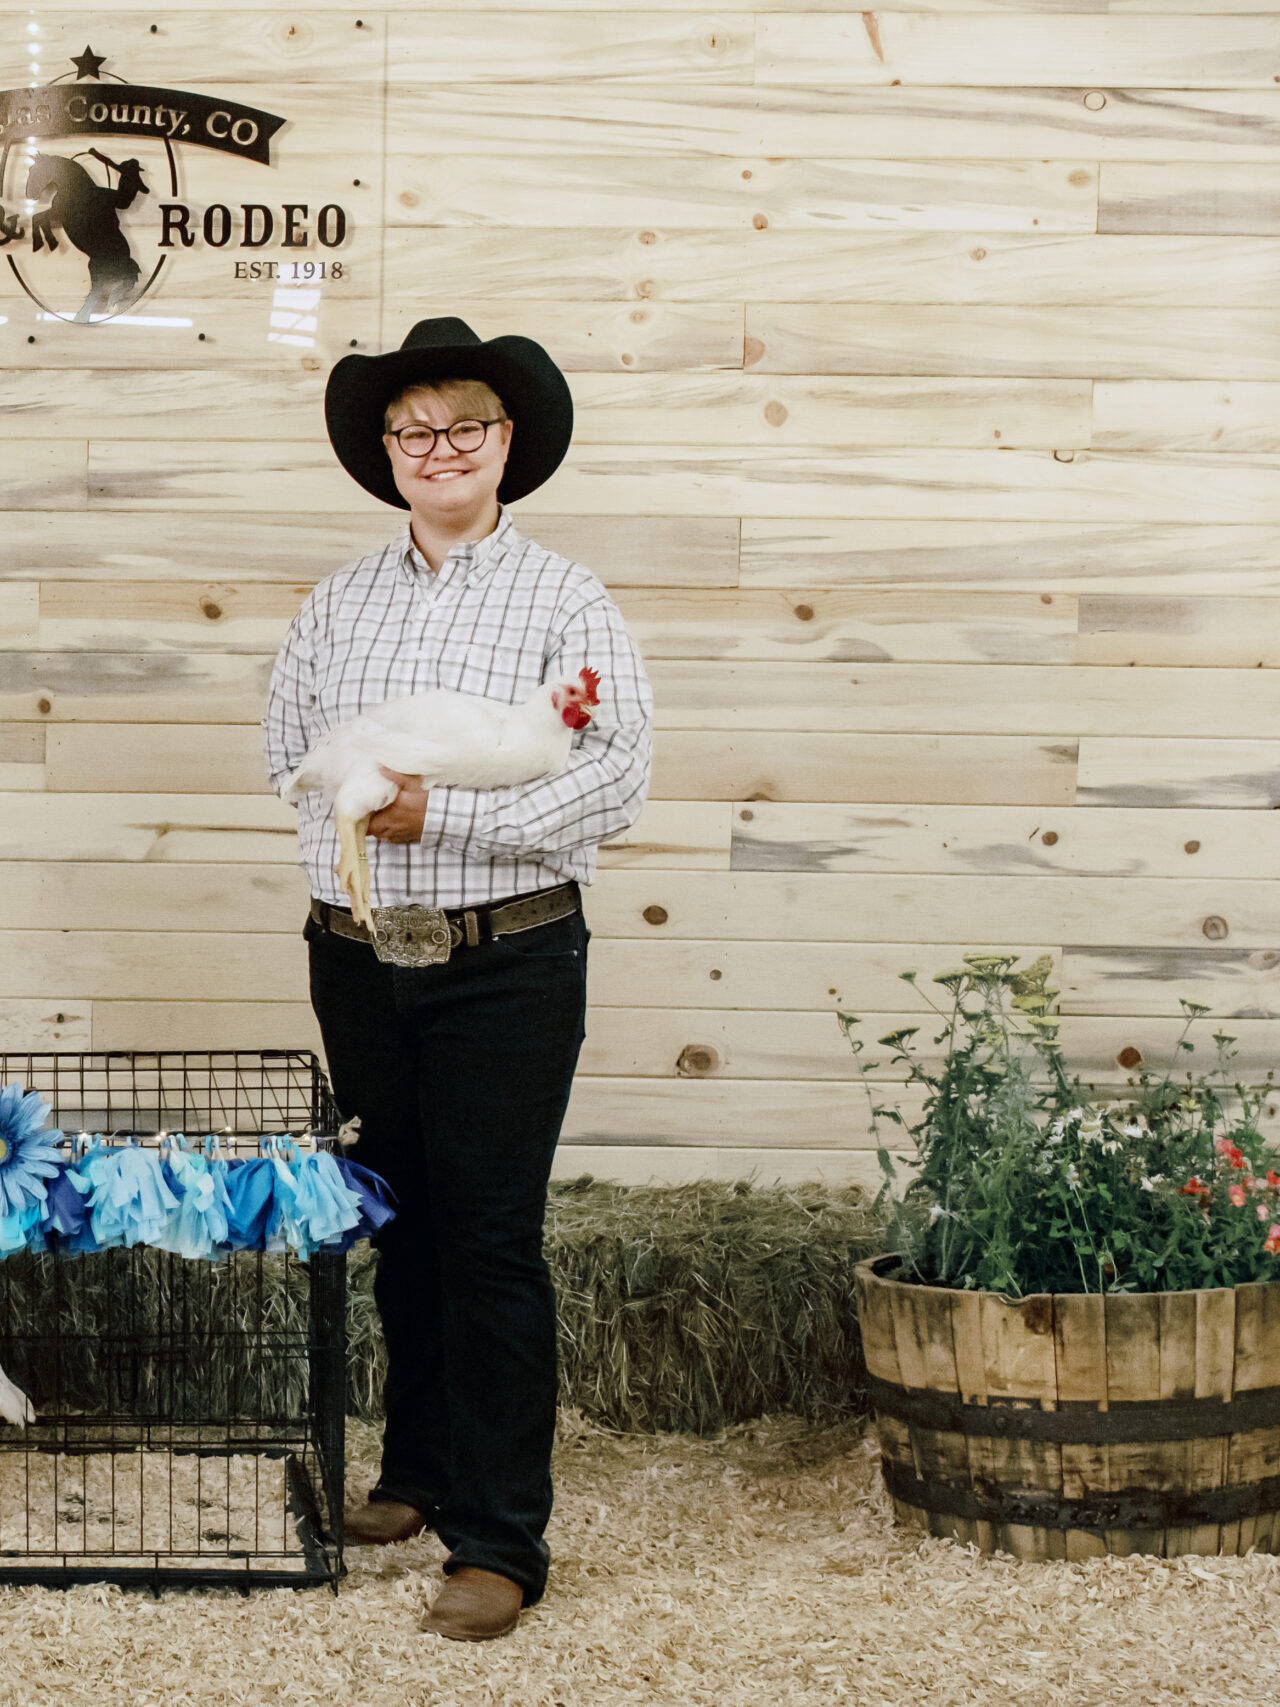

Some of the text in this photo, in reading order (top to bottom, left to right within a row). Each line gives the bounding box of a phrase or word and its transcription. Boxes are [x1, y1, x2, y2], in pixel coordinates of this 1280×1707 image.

[67, 95, 191, 137] County,
[205, 110, 260, 146] CO
[158, 203, 348, 248] RODEO
[233, 260, 344, 281] EST. 1918
